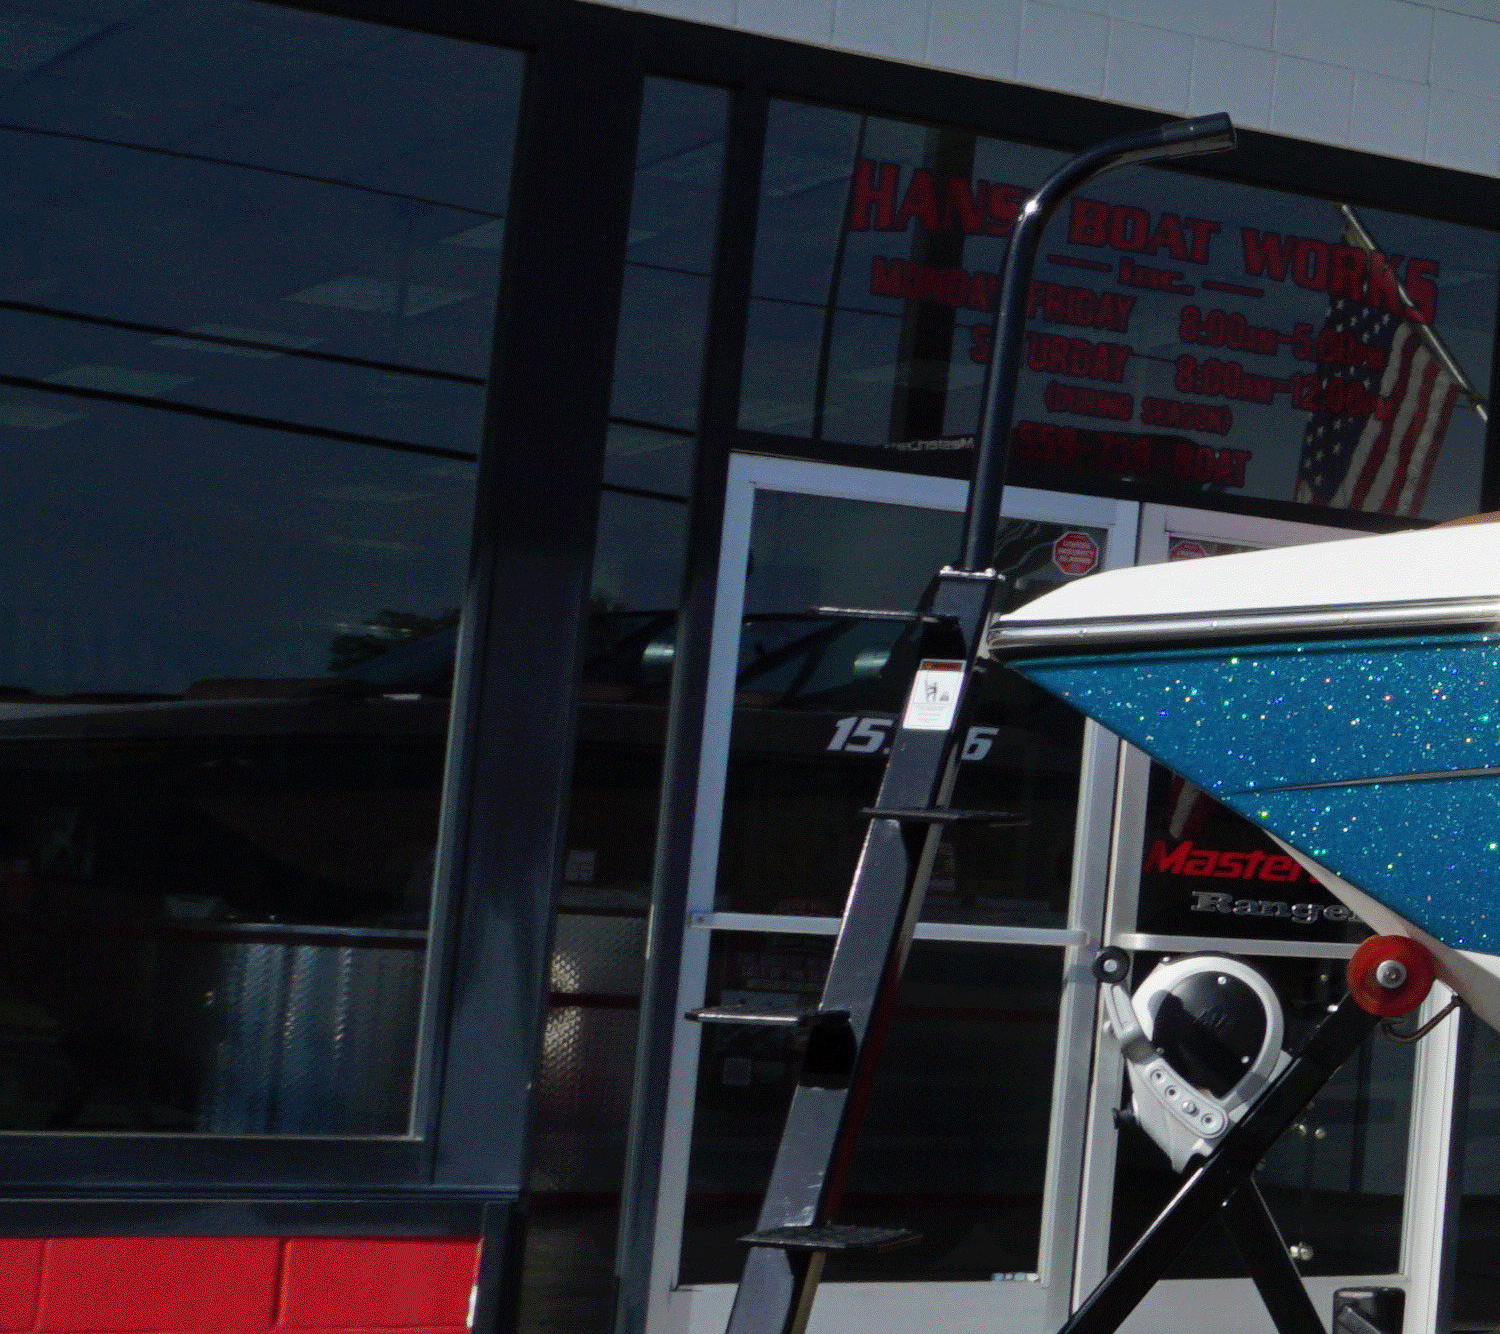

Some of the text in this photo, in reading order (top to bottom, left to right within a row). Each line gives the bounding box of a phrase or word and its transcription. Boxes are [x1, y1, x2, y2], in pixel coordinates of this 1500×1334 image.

[1067, 197, 1221, 265] BOAT
[1241, 227, 1440, 325] WORKS
[968, 322, 1134, 383] SURDAY
[1143, 838, 1321, 884] Master
